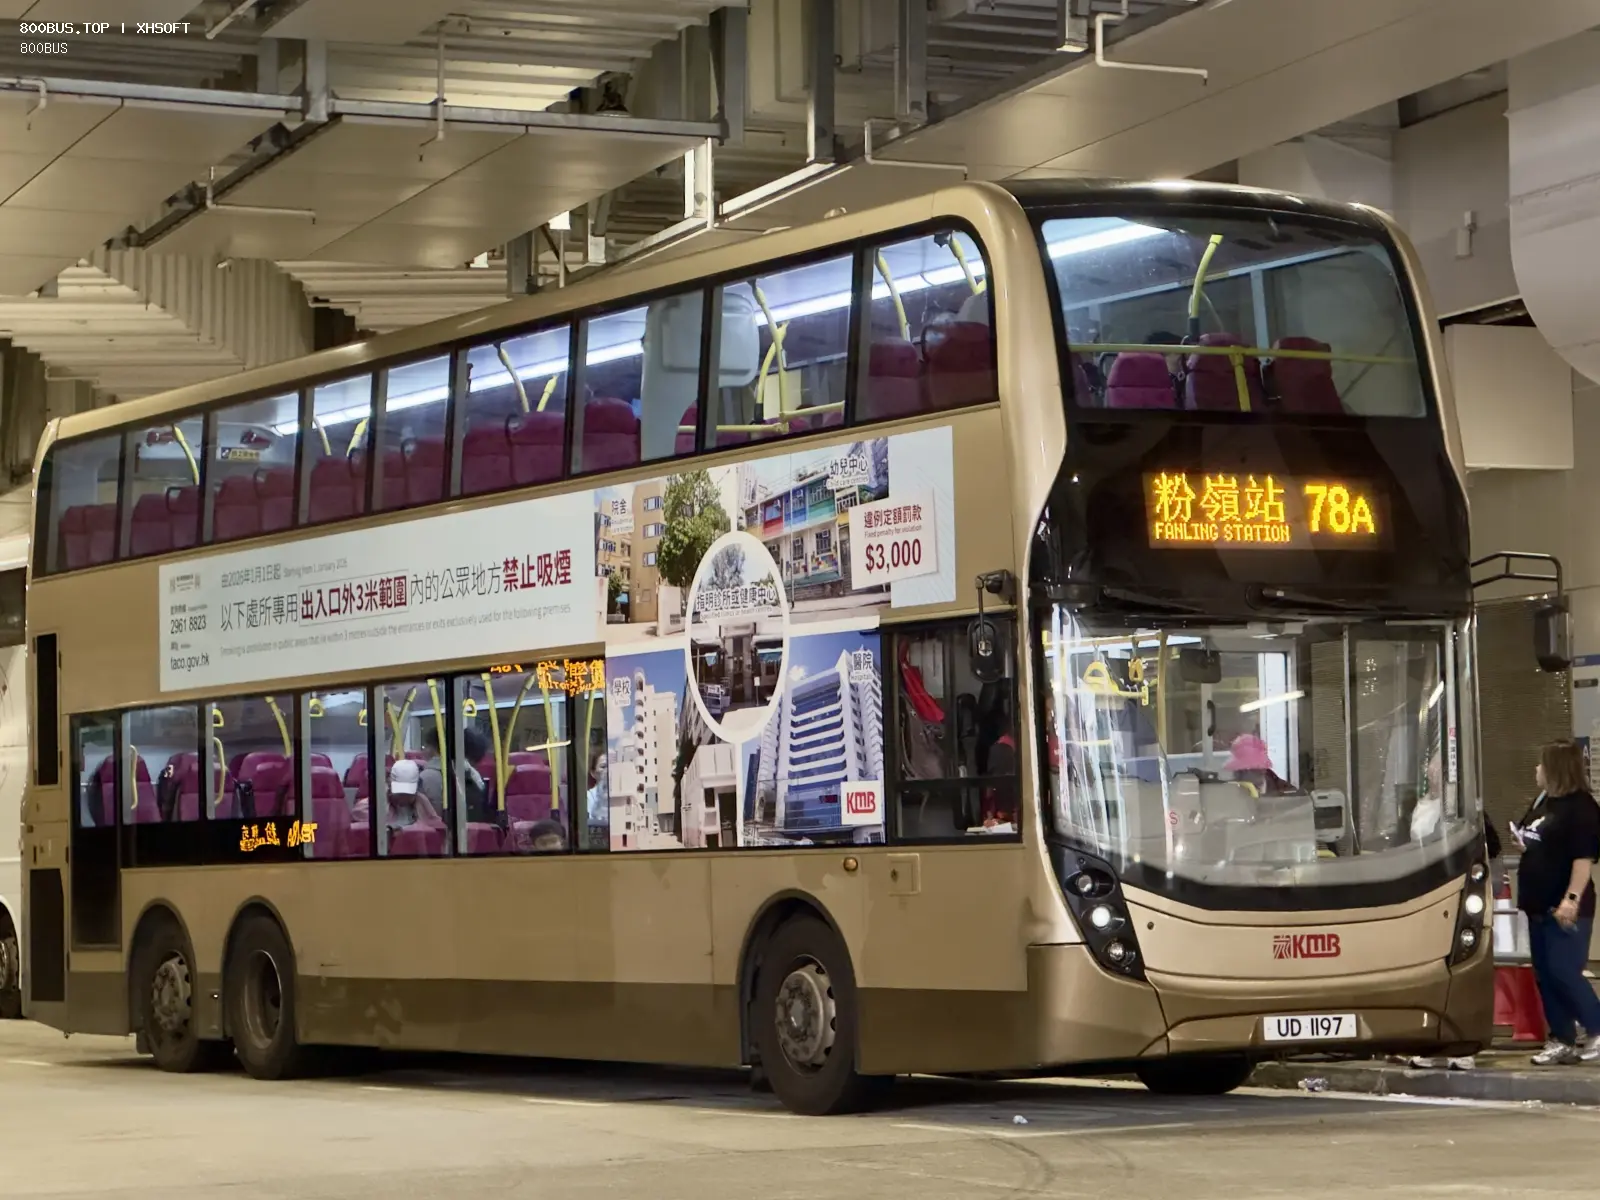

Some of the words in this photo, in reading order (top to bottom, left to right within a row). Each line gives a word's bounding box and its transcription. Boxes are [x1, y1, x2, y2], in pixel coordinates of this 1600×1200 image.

[830, 455, 867, 476] 幼兒中心
[611, 498, 628, 516] 院舍
[1154, 472, 1286, 523] 粉嶺站
[864, 504, 922, 529] 違例定額罰款
[1304, 484, 1376, 534] 78A
[877, 527, 894, 538] penalty
[1155, 522, 1219, 541] FANLING
[1223, 523, 1291, 542] STATION
[865, 538, 922, 574] $3,000
[170, 618, 187, 635] 2961
[189, 614, 207, 631] 8823
[853, 652, 873, 671] 醫院
[614, 680, 630, 696] 學校
[846, 791, 876, 814] KMB
[1292, 933, 1342, 959] KMB
[1277, 1018, 1302, 1037] UD
[1310, 1016, 1343, 1036] 1197
